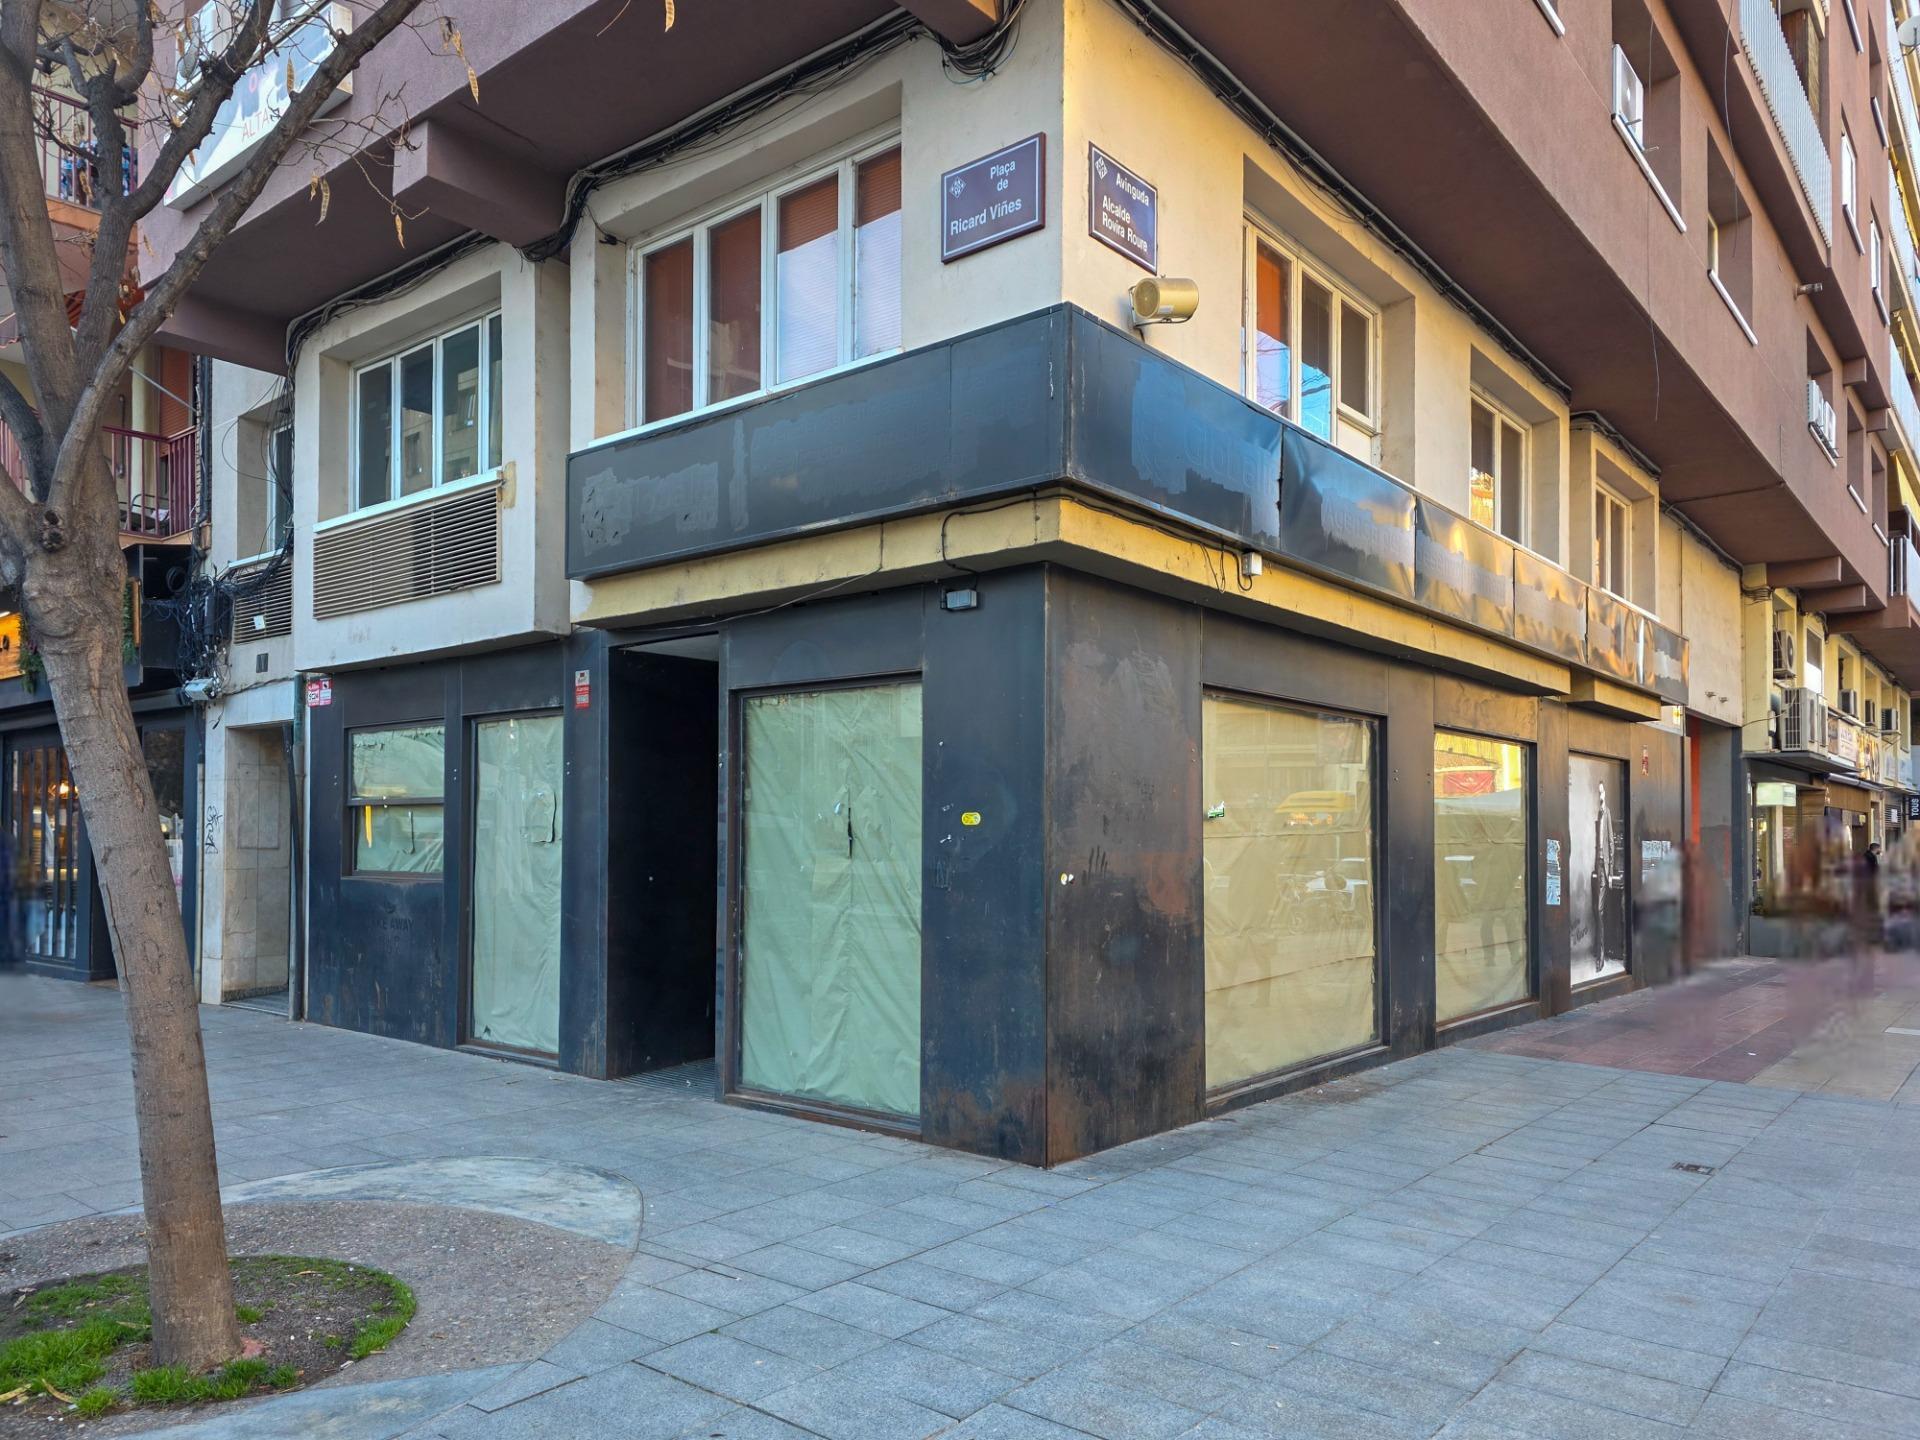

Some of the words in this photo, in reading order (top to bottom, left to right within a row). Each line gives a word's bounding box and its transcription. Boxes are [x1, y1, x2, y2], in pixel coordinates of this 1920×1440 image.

[990, 160, 1016, 179] Plaça
[996, 178, 1009, 191] de
[1116, 172, 1149, 207] Avinguda
[950, 208, 987, 236] Ricard
[989, 198, 1022, 220] Viñes
[1102, 195, 1131, 224] Alcalde
[1102, 211, 1125, 238] Rovira
[1127, 227, 1148, 252] Roure
[1911, 798, 1920, 817] TOUS
